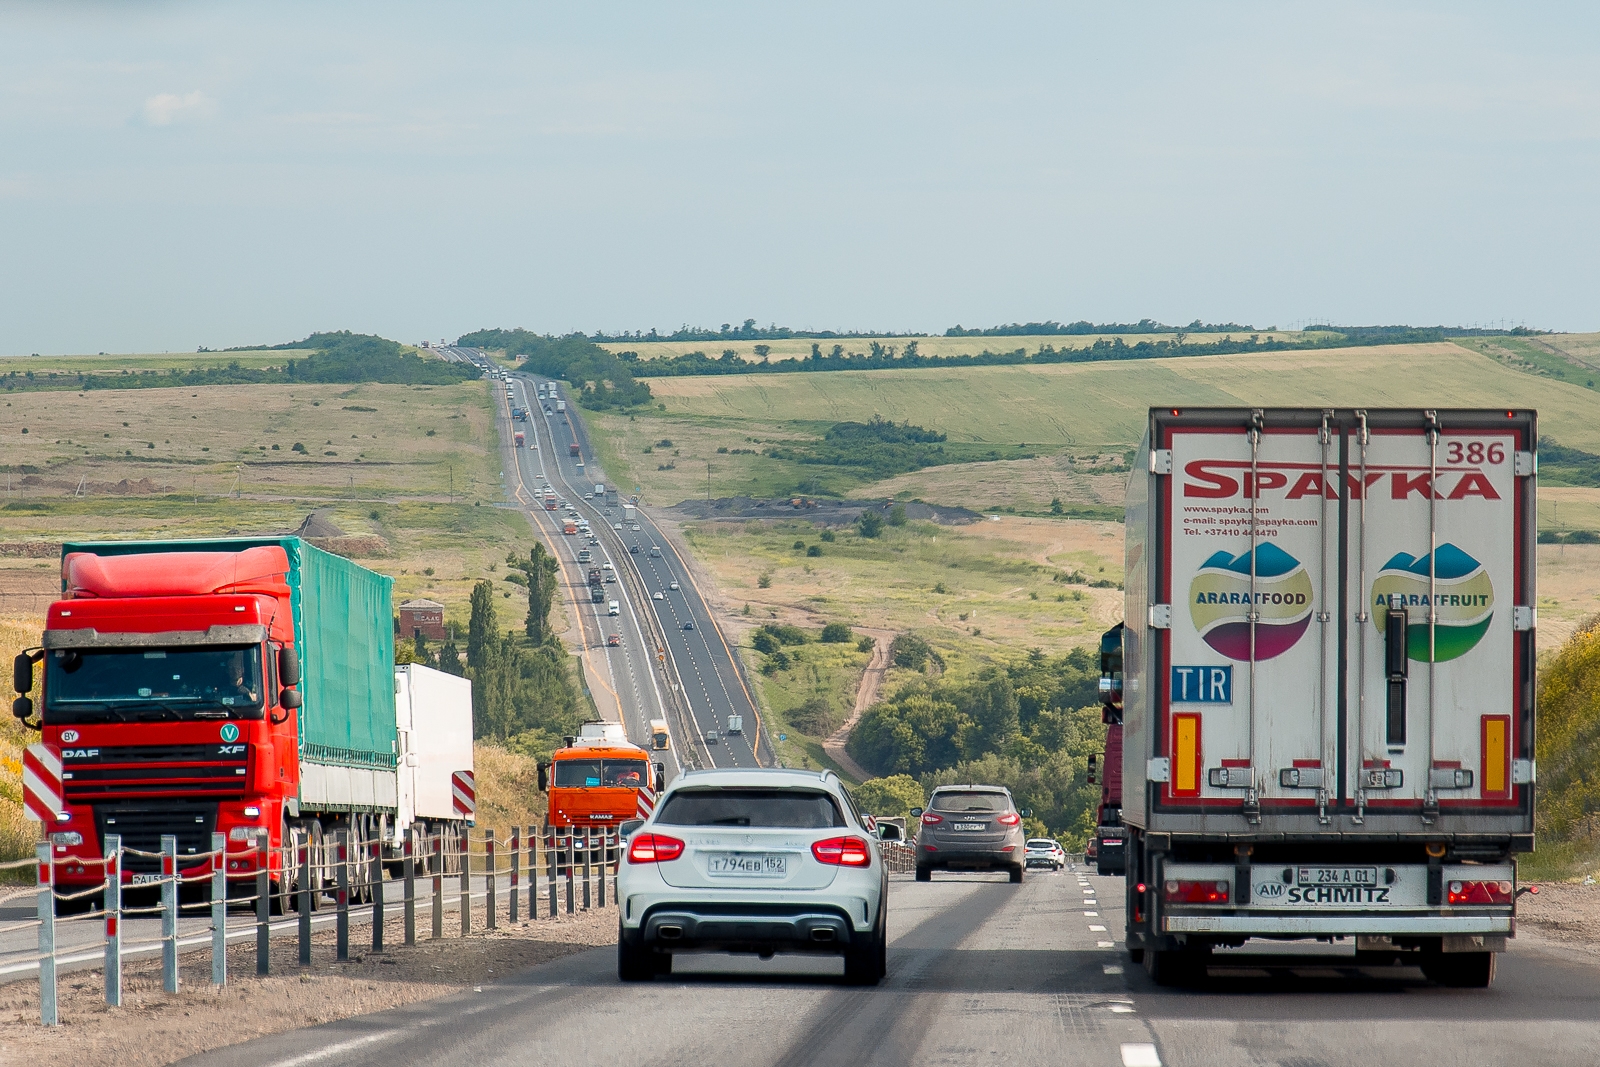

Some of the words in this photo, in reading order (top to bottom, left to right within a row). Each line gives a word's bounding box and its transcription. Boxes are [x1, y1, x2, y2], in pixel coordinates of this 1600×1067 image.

[1446, 441, 1505, 465] 386
[1183, 459, 1502, 501] SPAYKA
[1183, 516, 1217, 525] e-mail:
[1183, 528, 1202, 536] Tel.
[1204, 528, 1240, 537] +37410
[1176, 669, 1226, 701] TIR
[64, 732, 76, 741] BY
[225, 727, 235, 740] V
[62, 749, 99, 759] DAF
[217, 746, 246, 754] XF
[764, 858, 783, 869] 152
[1318, 870, 1338, 882] 234
[1343, 870, 1351, 882] A
[1355, 870, 1369, 882] 01
[1259, 885, 1282, 895] AM
[1288, 887, 1390, 903] SCHMITZ
